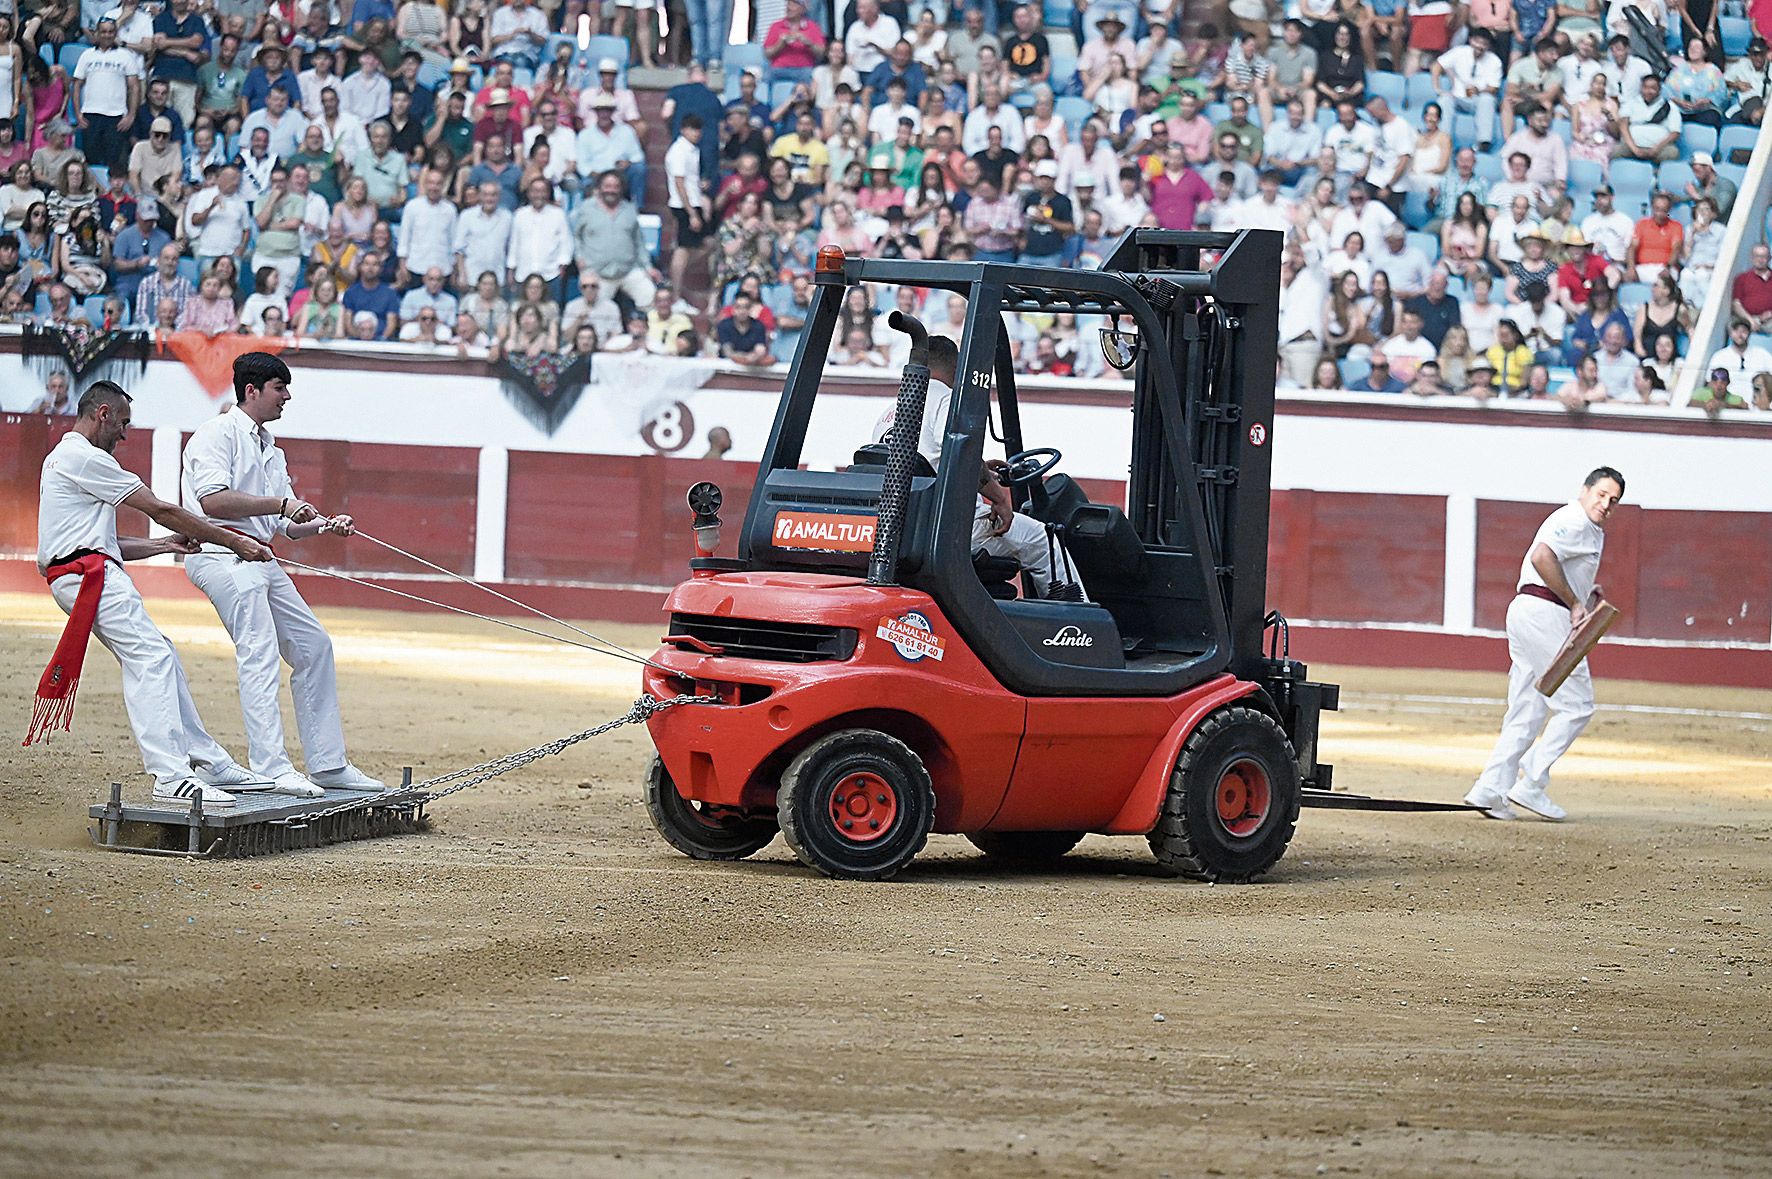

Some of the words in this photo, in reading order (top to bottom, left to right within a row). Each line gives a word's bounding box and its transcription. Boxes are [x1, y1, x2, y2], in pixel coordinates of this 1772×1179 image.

[971, 370, 991, 390] 312
[653, 403, 684, 450] 8
[888, 631, 904, 644] 626
[905, 637, 915, 648] 61
[916, 642, 927, 653] 81
[928, 647, 939, 657] 40
[1042, 625, 1093, 647] Linde
